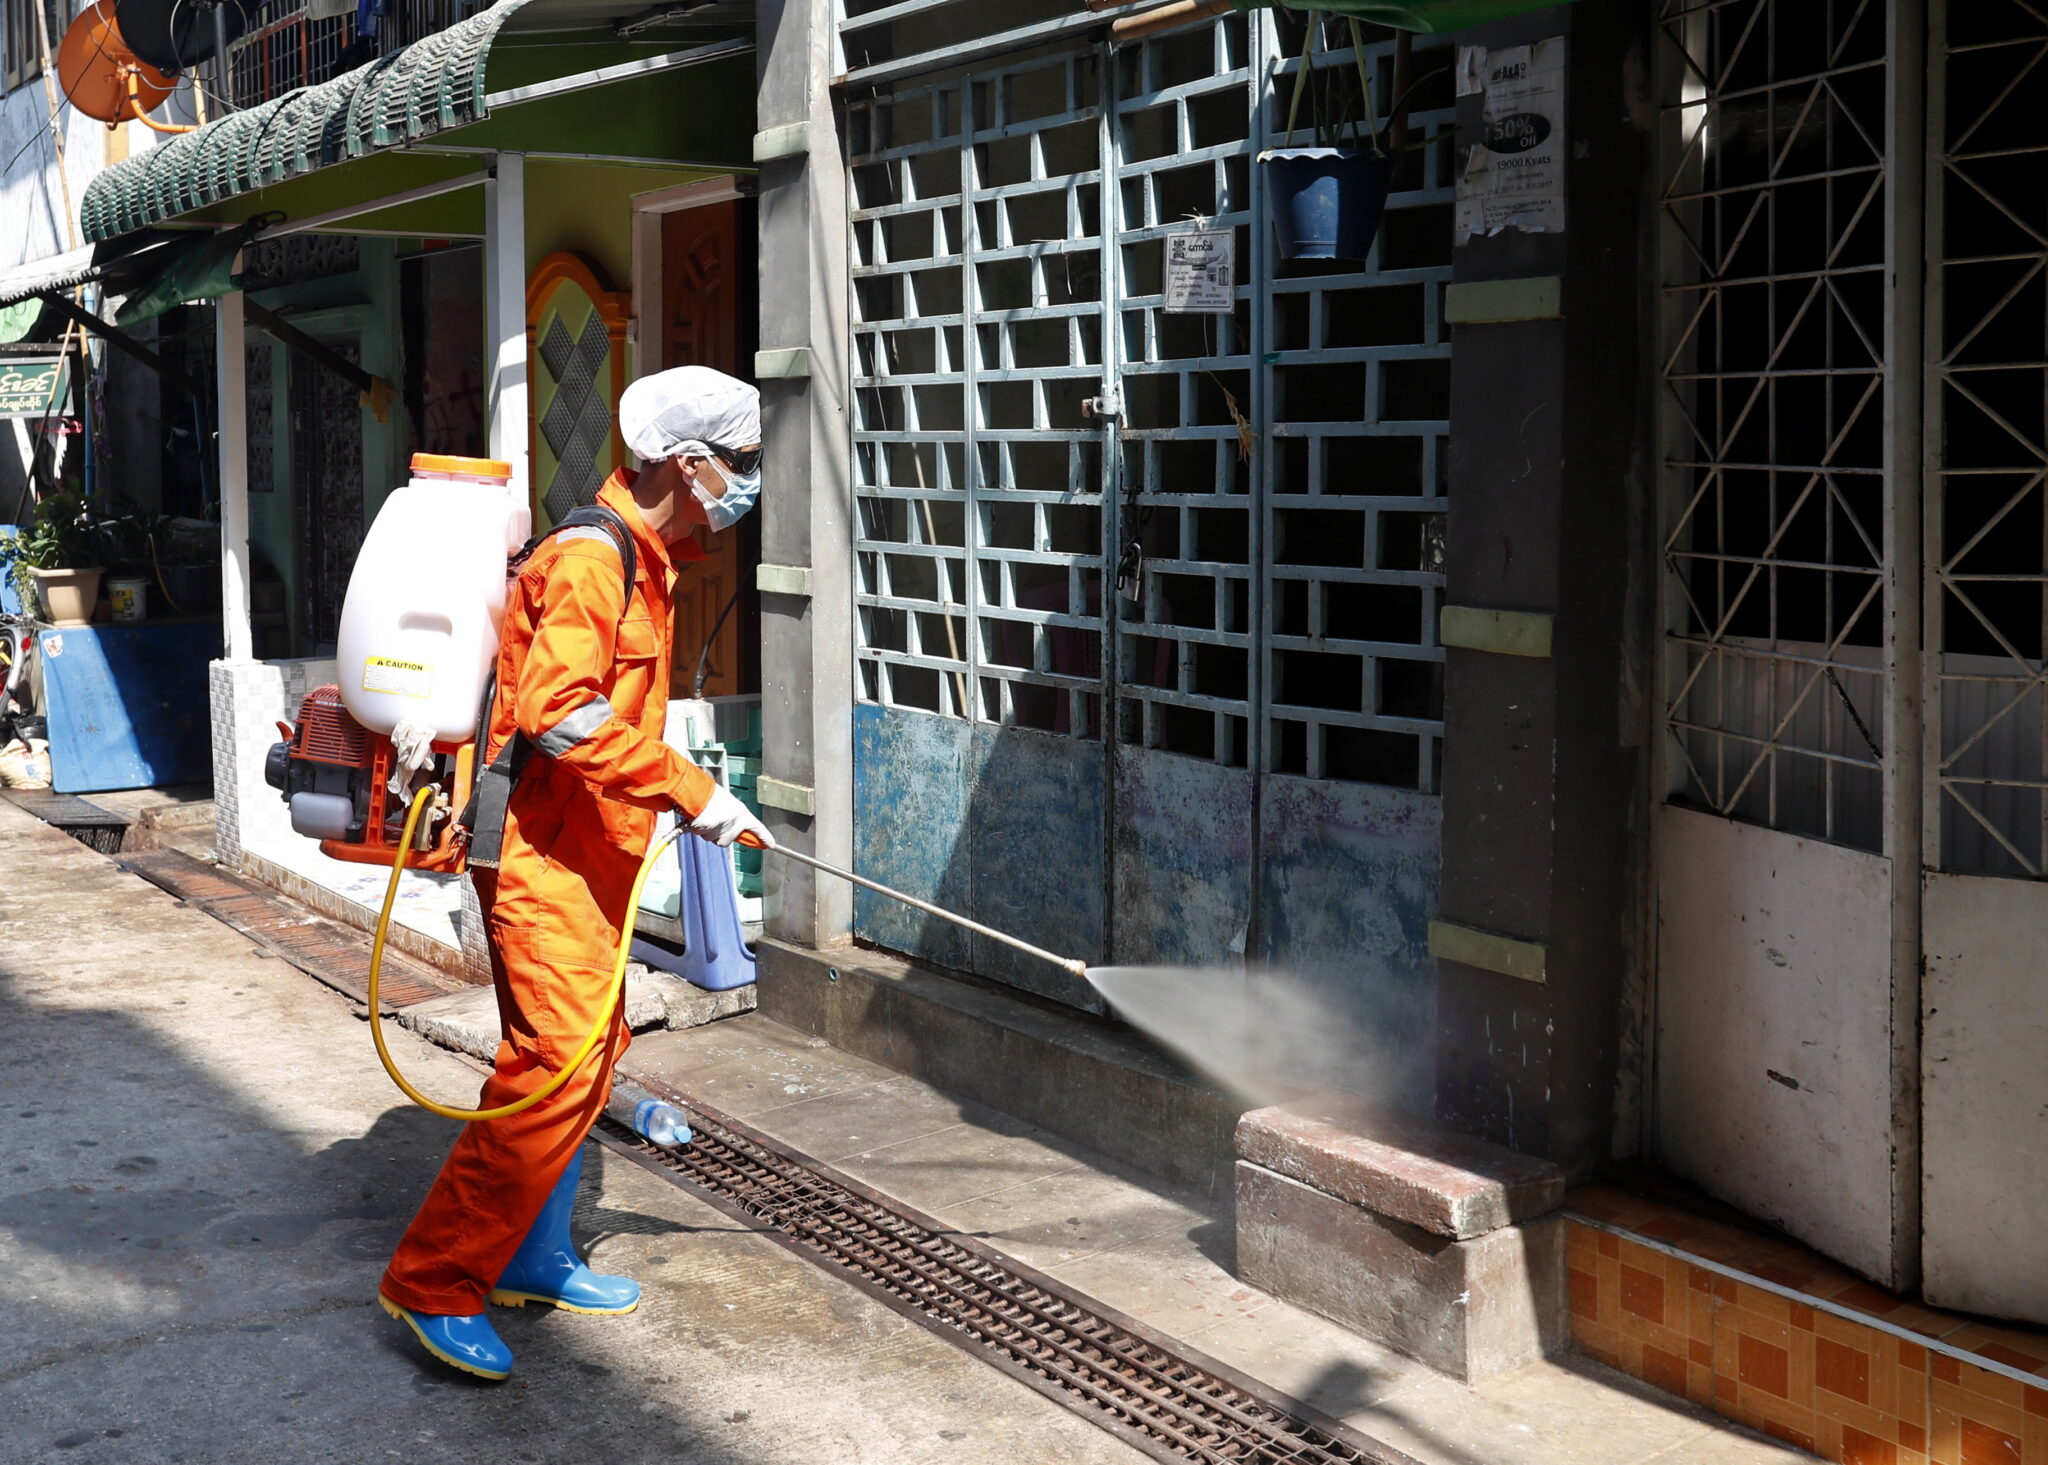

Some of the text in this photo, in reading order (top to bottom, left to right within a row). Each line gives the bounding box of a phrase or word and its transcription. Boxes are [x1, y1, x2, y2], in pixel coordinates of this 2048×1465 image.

[1494, 116, 1535, 141] 50%
[1520, 134, 1537, 148] Off
[1497, 155, 1551, 171] 19000 Kyats
[386, 660, 423, 671] CAUTION
